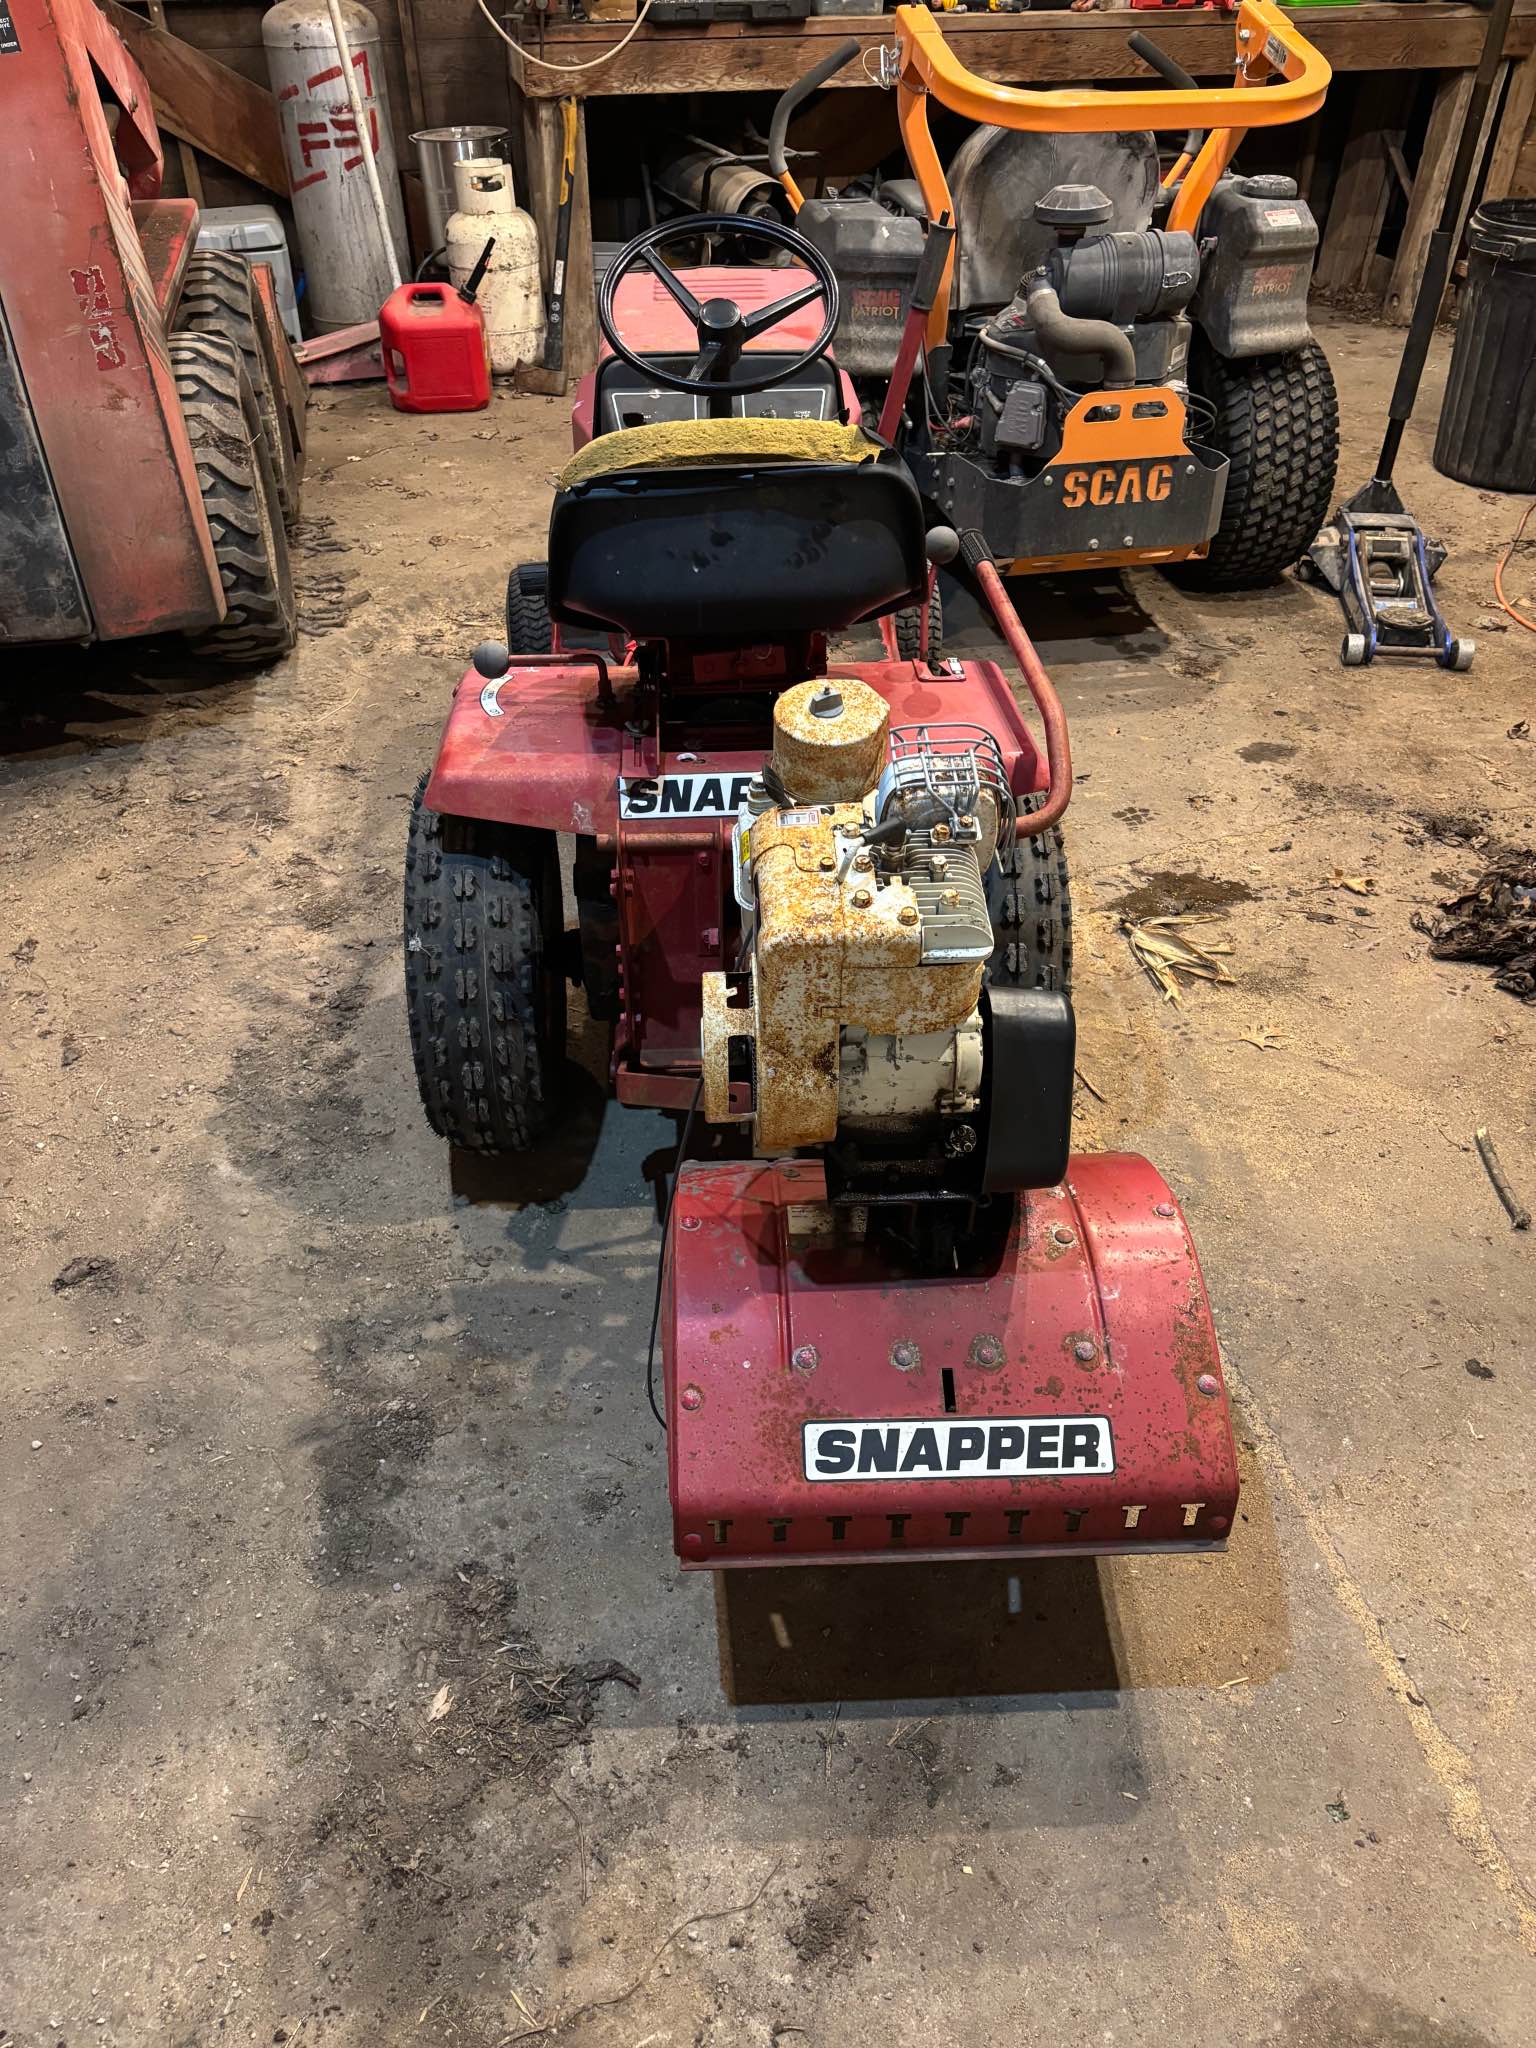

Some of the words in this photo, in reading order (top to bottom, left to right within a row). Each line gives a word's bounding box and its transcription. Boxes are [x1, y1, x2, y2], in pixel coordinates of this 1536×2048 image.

[1252, 282, 1292, 297] PATRIOT
[851, 305, 900, 320] PATRIOT
[1062, 464, 1173, 508] SCAG
[815, 1424, 1101, 1474] SNAPPER
